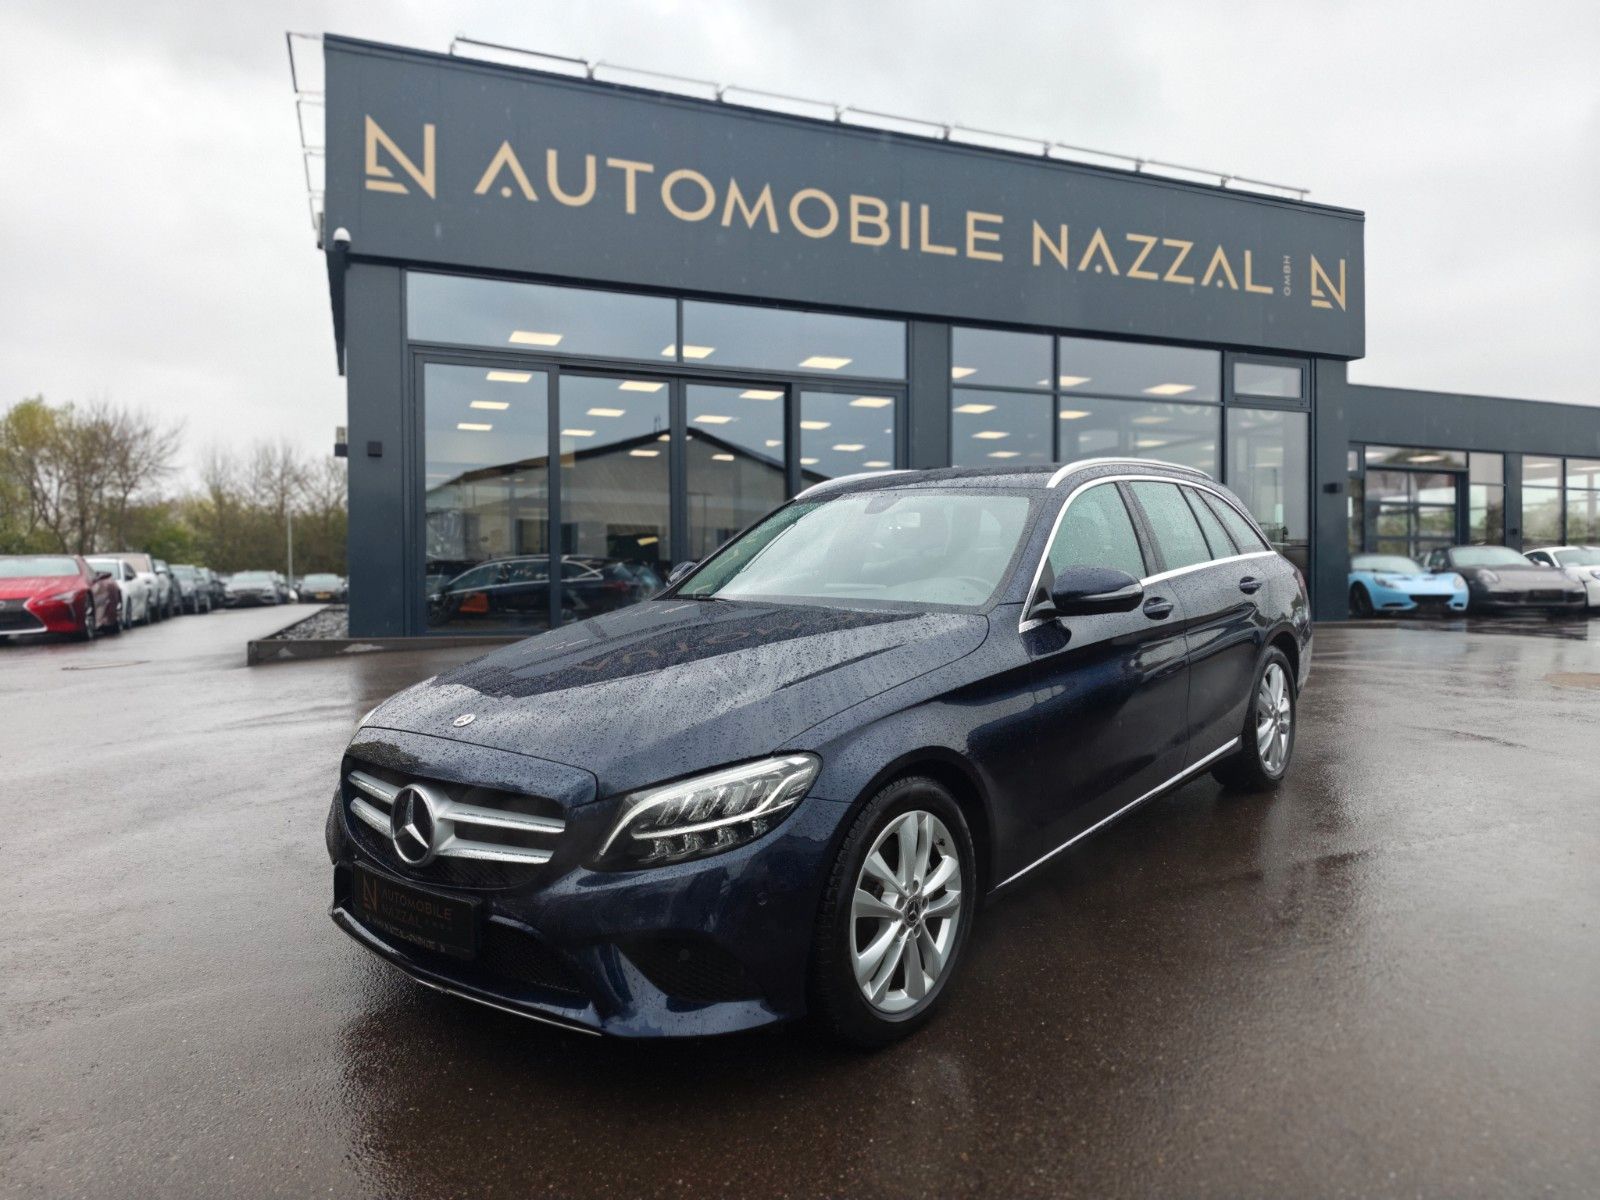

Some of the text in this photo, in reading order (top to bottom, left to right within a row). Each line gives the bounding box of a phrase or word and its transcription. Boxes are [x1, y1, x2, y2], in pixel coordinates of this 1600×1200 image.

[473, 140, 1274, 295] AUTOMOBILE NAZZAL
[382, 888, 453, 921] AUTOMOBILE
